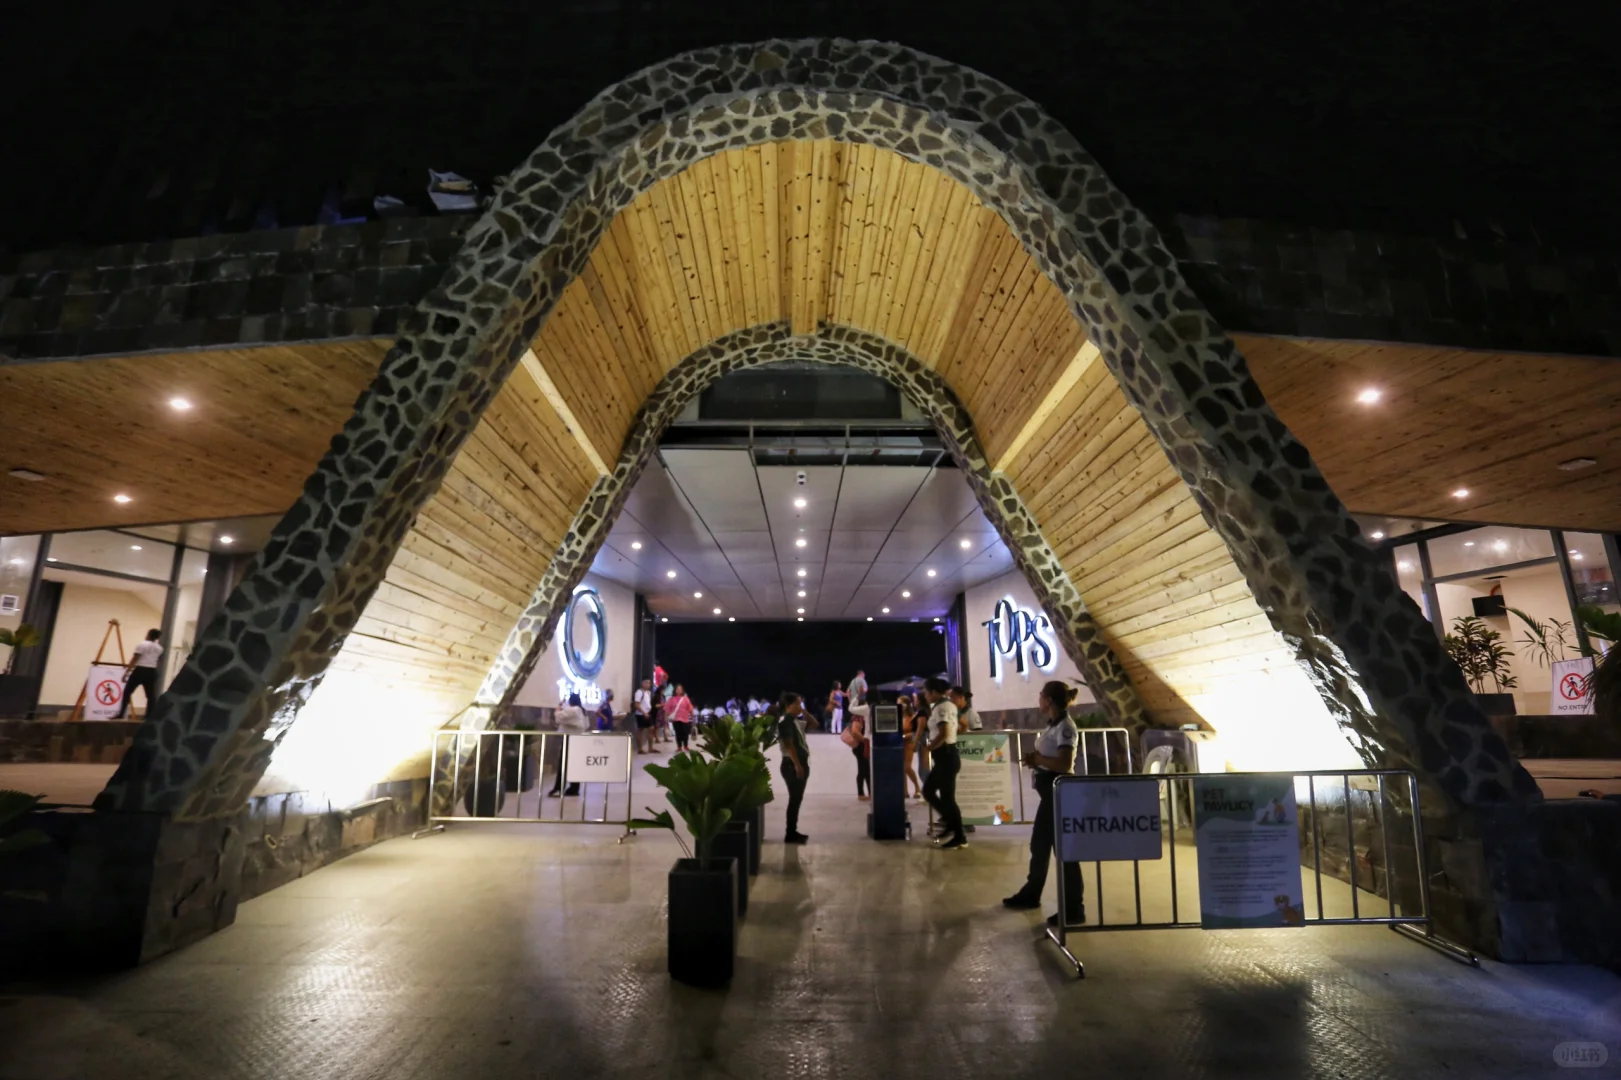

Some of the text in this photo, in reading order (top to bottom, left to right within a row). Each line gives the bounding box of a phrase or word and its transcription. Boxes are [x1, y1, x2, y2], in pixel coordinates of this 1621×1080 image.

[586, 756, 609, 766] EXIT
[1203, 788, 1224, 799] PET
[1203, 799, 1254, 812] PAWLICY
[1062, 814, 1161, 834] ENTRANCE
